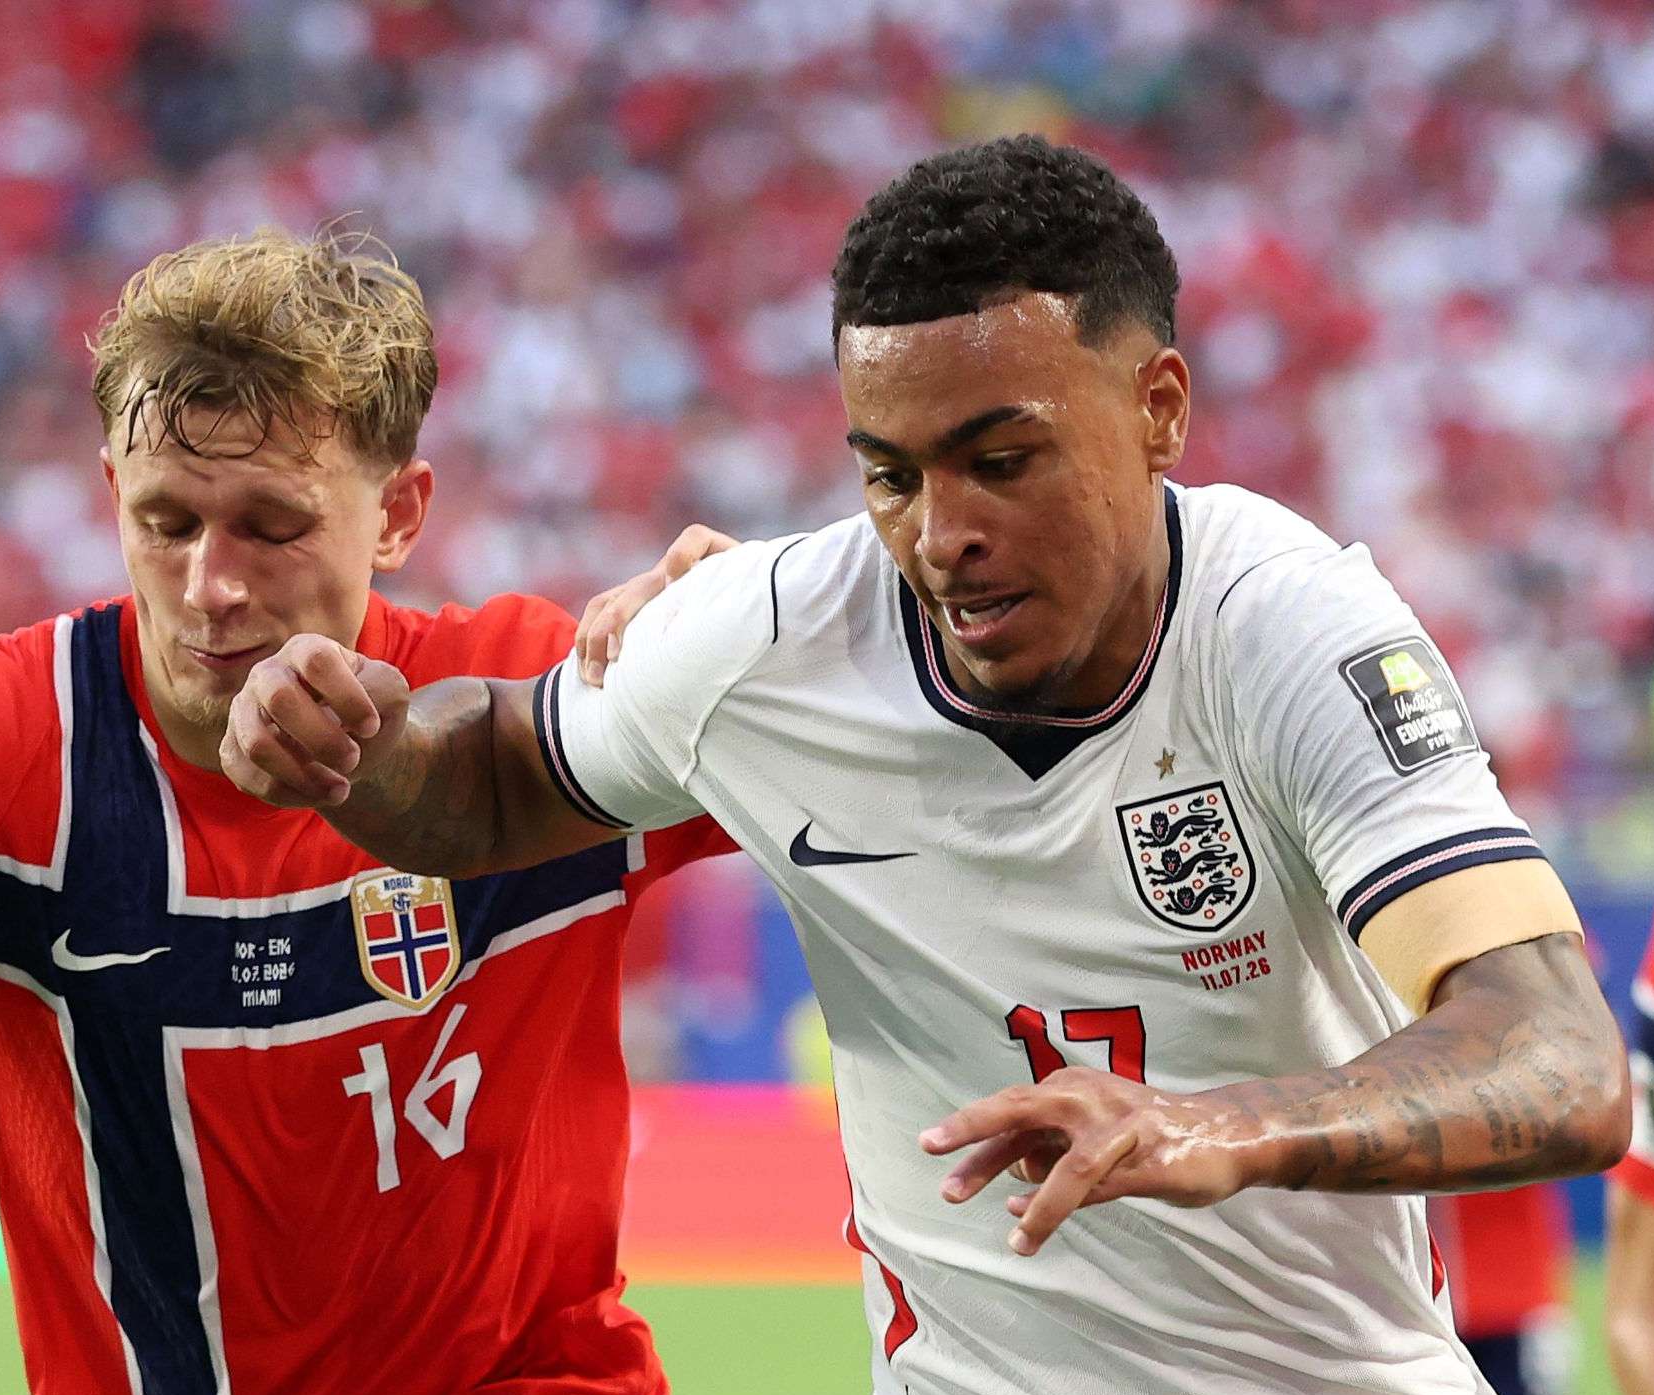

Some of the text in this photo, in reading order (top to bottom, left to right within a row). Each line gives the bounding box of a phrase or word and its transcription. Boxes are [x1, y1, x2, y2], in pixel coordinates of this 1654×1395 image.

[383, 876, 414, 891] NORGE
[1181, 930, 1266, 972] NORWAY
[1200, 957, 1271, 991] 11.07.26
[242, 988, 281, 1007] MIAMI
[1004, 1004, 1146, 1085] 17
[341, 1003, 482, 1193] 16
